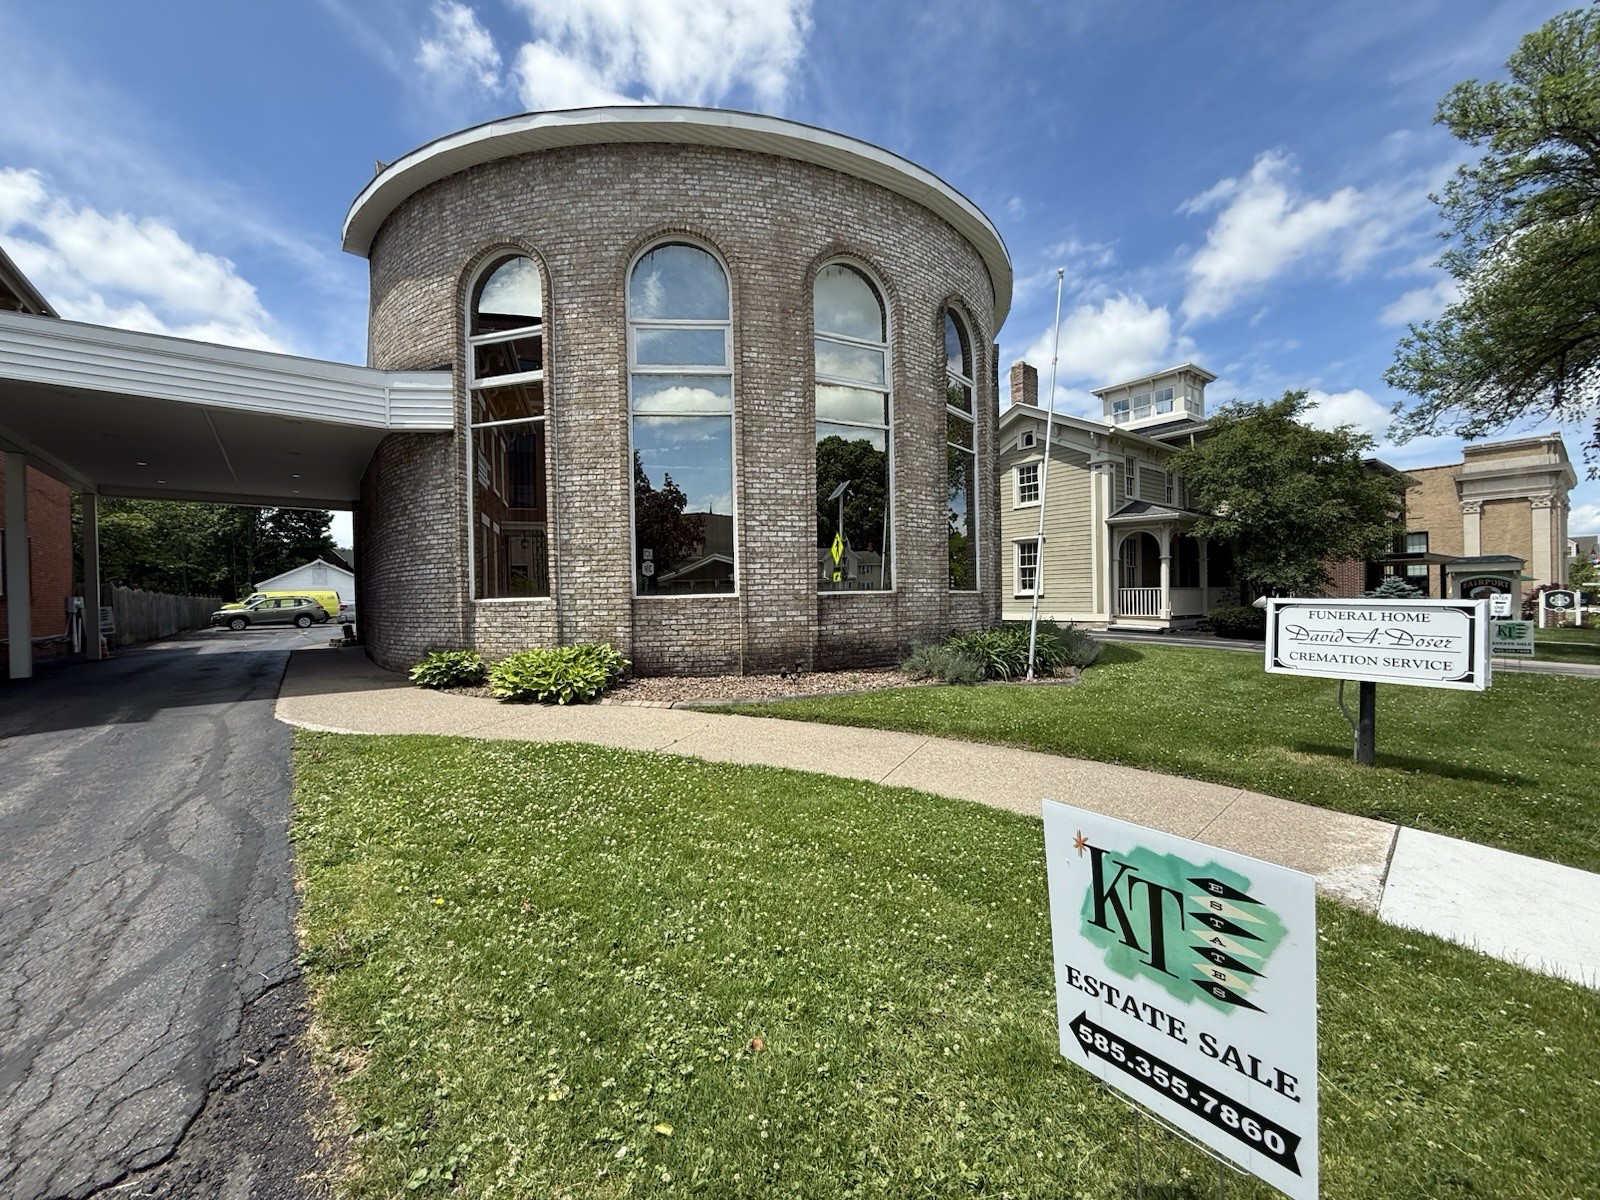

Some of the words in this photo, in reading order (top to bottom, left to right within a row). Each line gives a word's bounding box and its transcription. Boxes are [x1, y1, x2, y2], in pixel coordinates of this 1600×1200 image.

[1462, 579, 1510, 589] FAIRPORT
[1308, 610, 1377, 622] FUNERAL
[1381, 612, 1431, 623] HOME
[1285, 624, 1344, 643] David
[1346, 627, 1381, 645] A.
[1384, 628, 1453, 648] Doser
[1497, 624, 1516, 638] KT
[1289, 651, 1379, 666] CREMATION
[1382, 656, 1453, 671] SERVICE
[1081, 842, 1186, 980] KT
[1207, 880, 1227, 1000] ESTATES
[1064, 964, 1188, 1045] ESTATE
[1199, 1032, 1301, 1104] SALE
[1078, 1023, 1286, 1156] 585.355.7860
